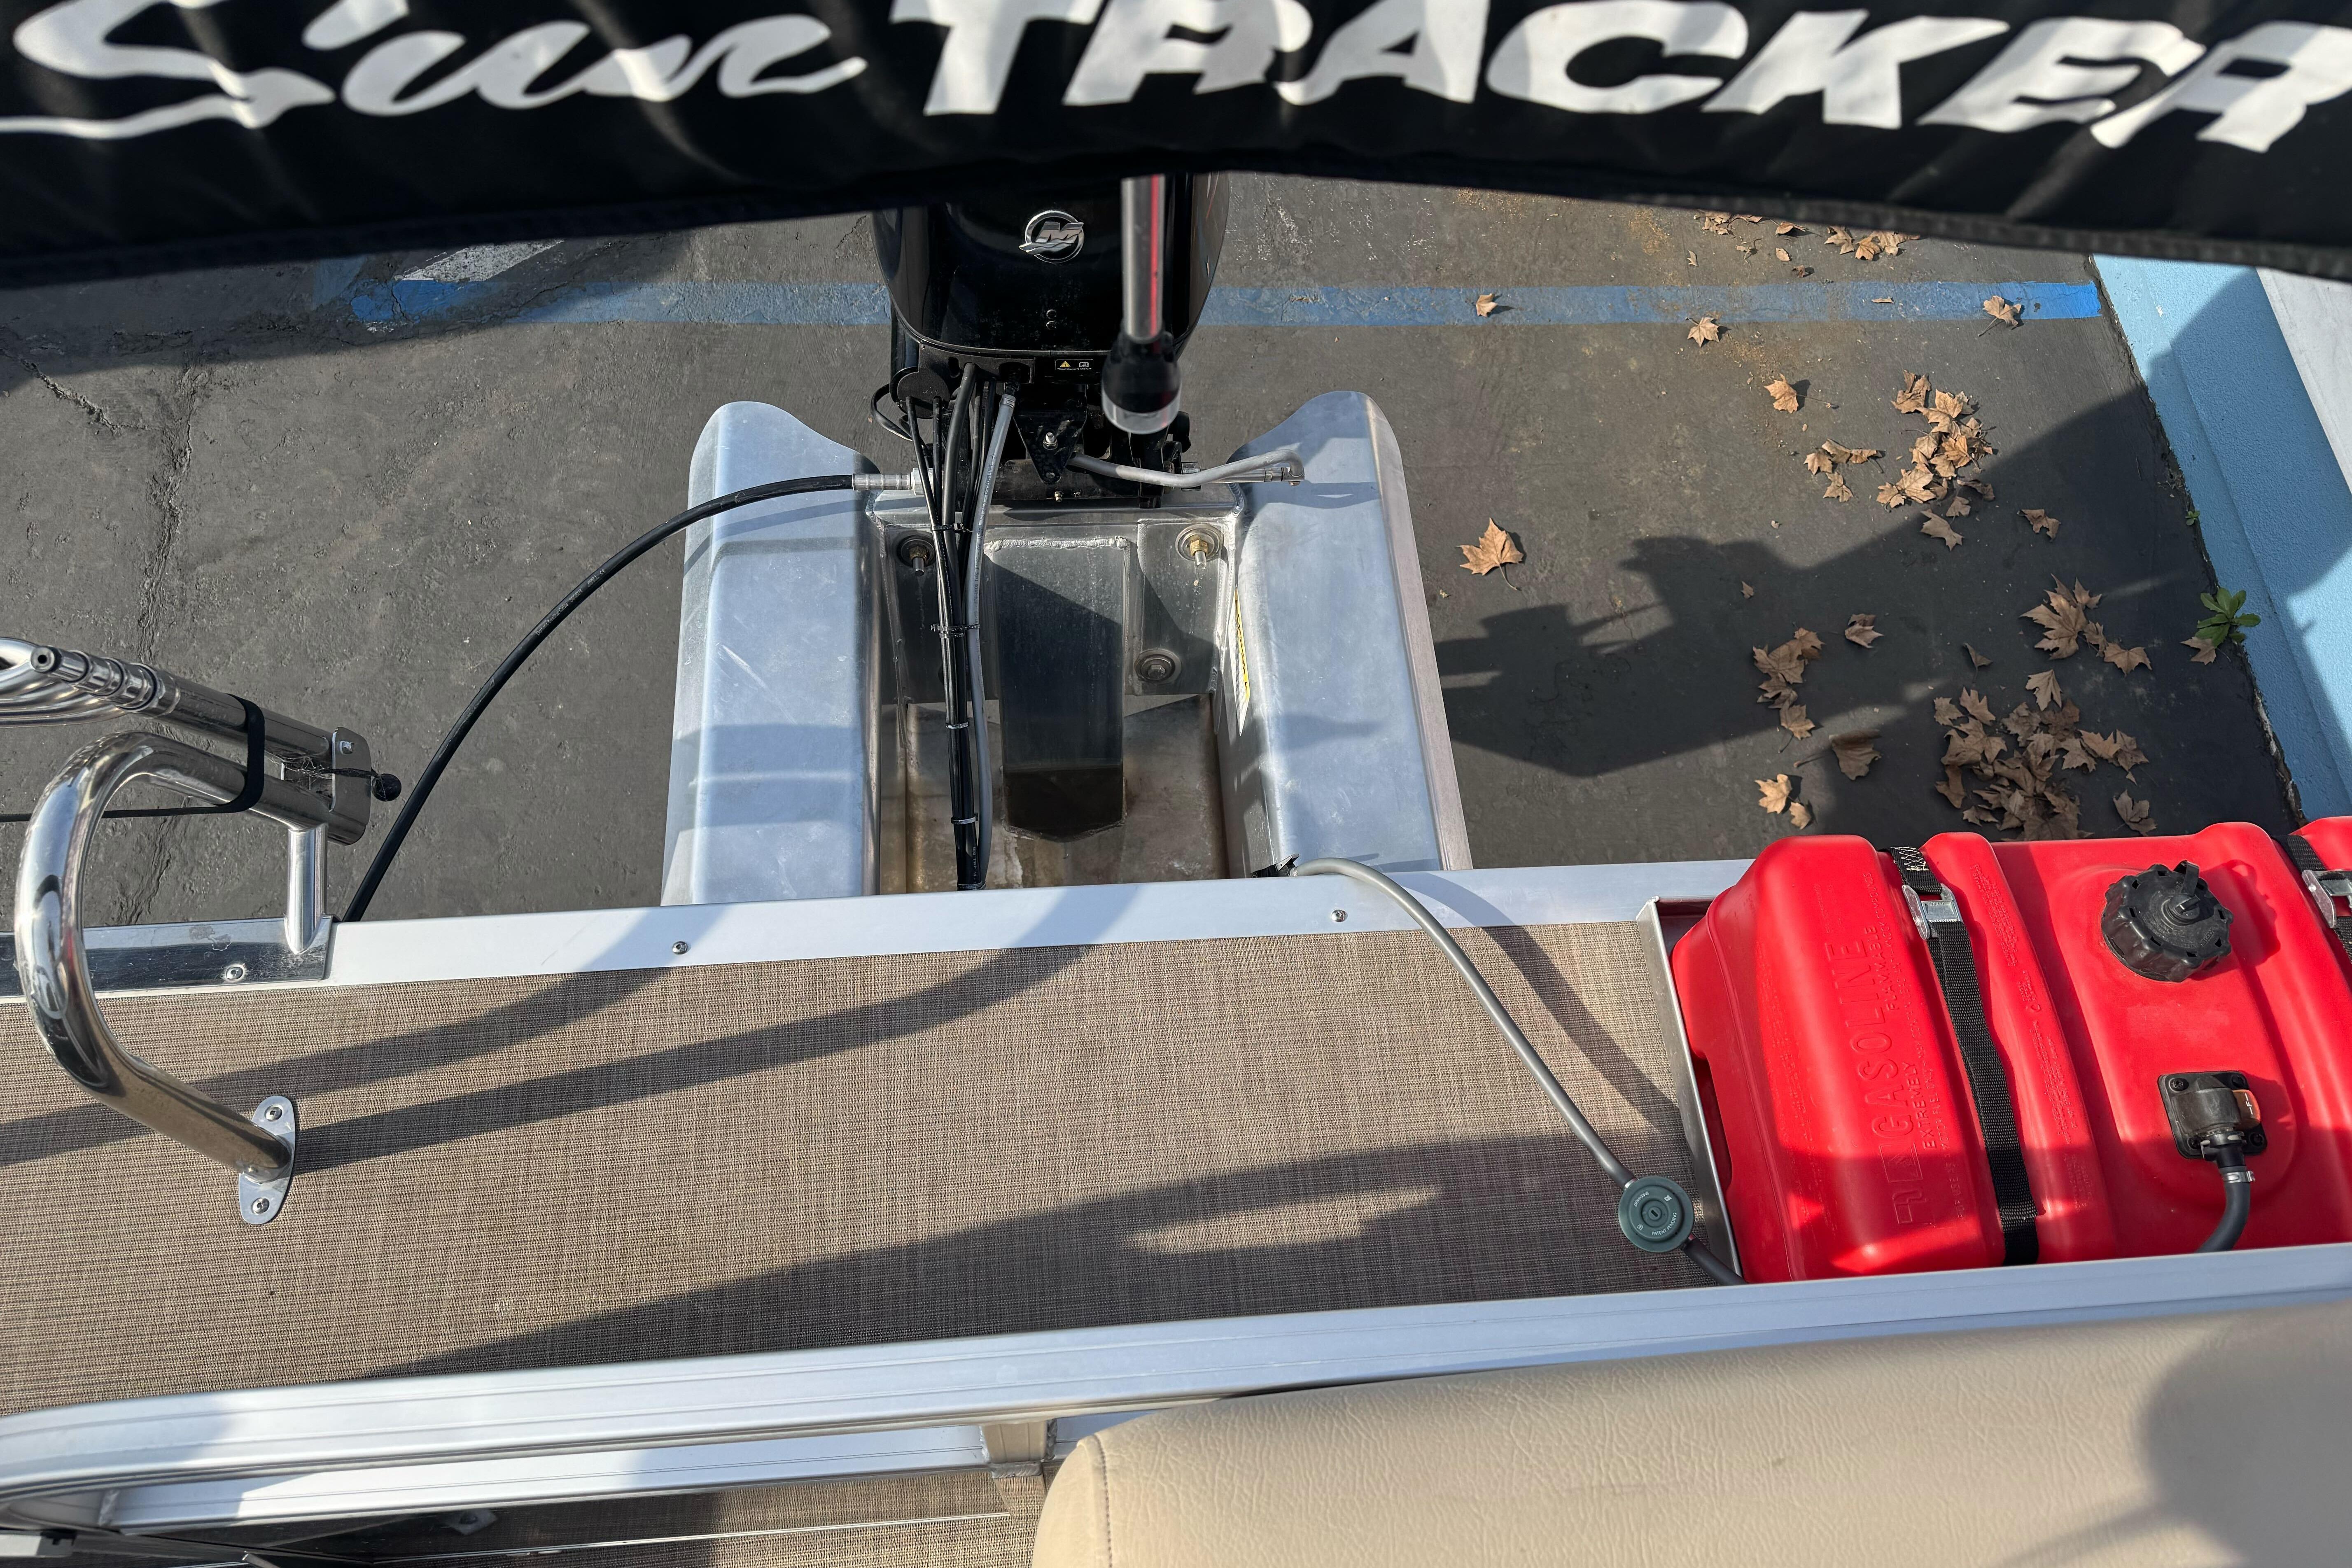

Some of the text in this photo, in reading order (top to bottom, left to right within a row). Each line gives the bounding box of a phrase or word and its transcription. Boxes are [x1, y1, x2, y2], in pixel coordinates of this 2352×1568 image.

[0, 0, 2352, 153] Sun TRACKER
[1825, 939, 1914, 1139] GASOLINE
[1864, 925, 1935, 1149] EXTREMELY FLAMMABLE
[1929, 1092, 1940, 1114] FUEL
[1935, 1118, 1951, 1150] MOTOR
[1666, 1212, 1677, 1230] PENDING
